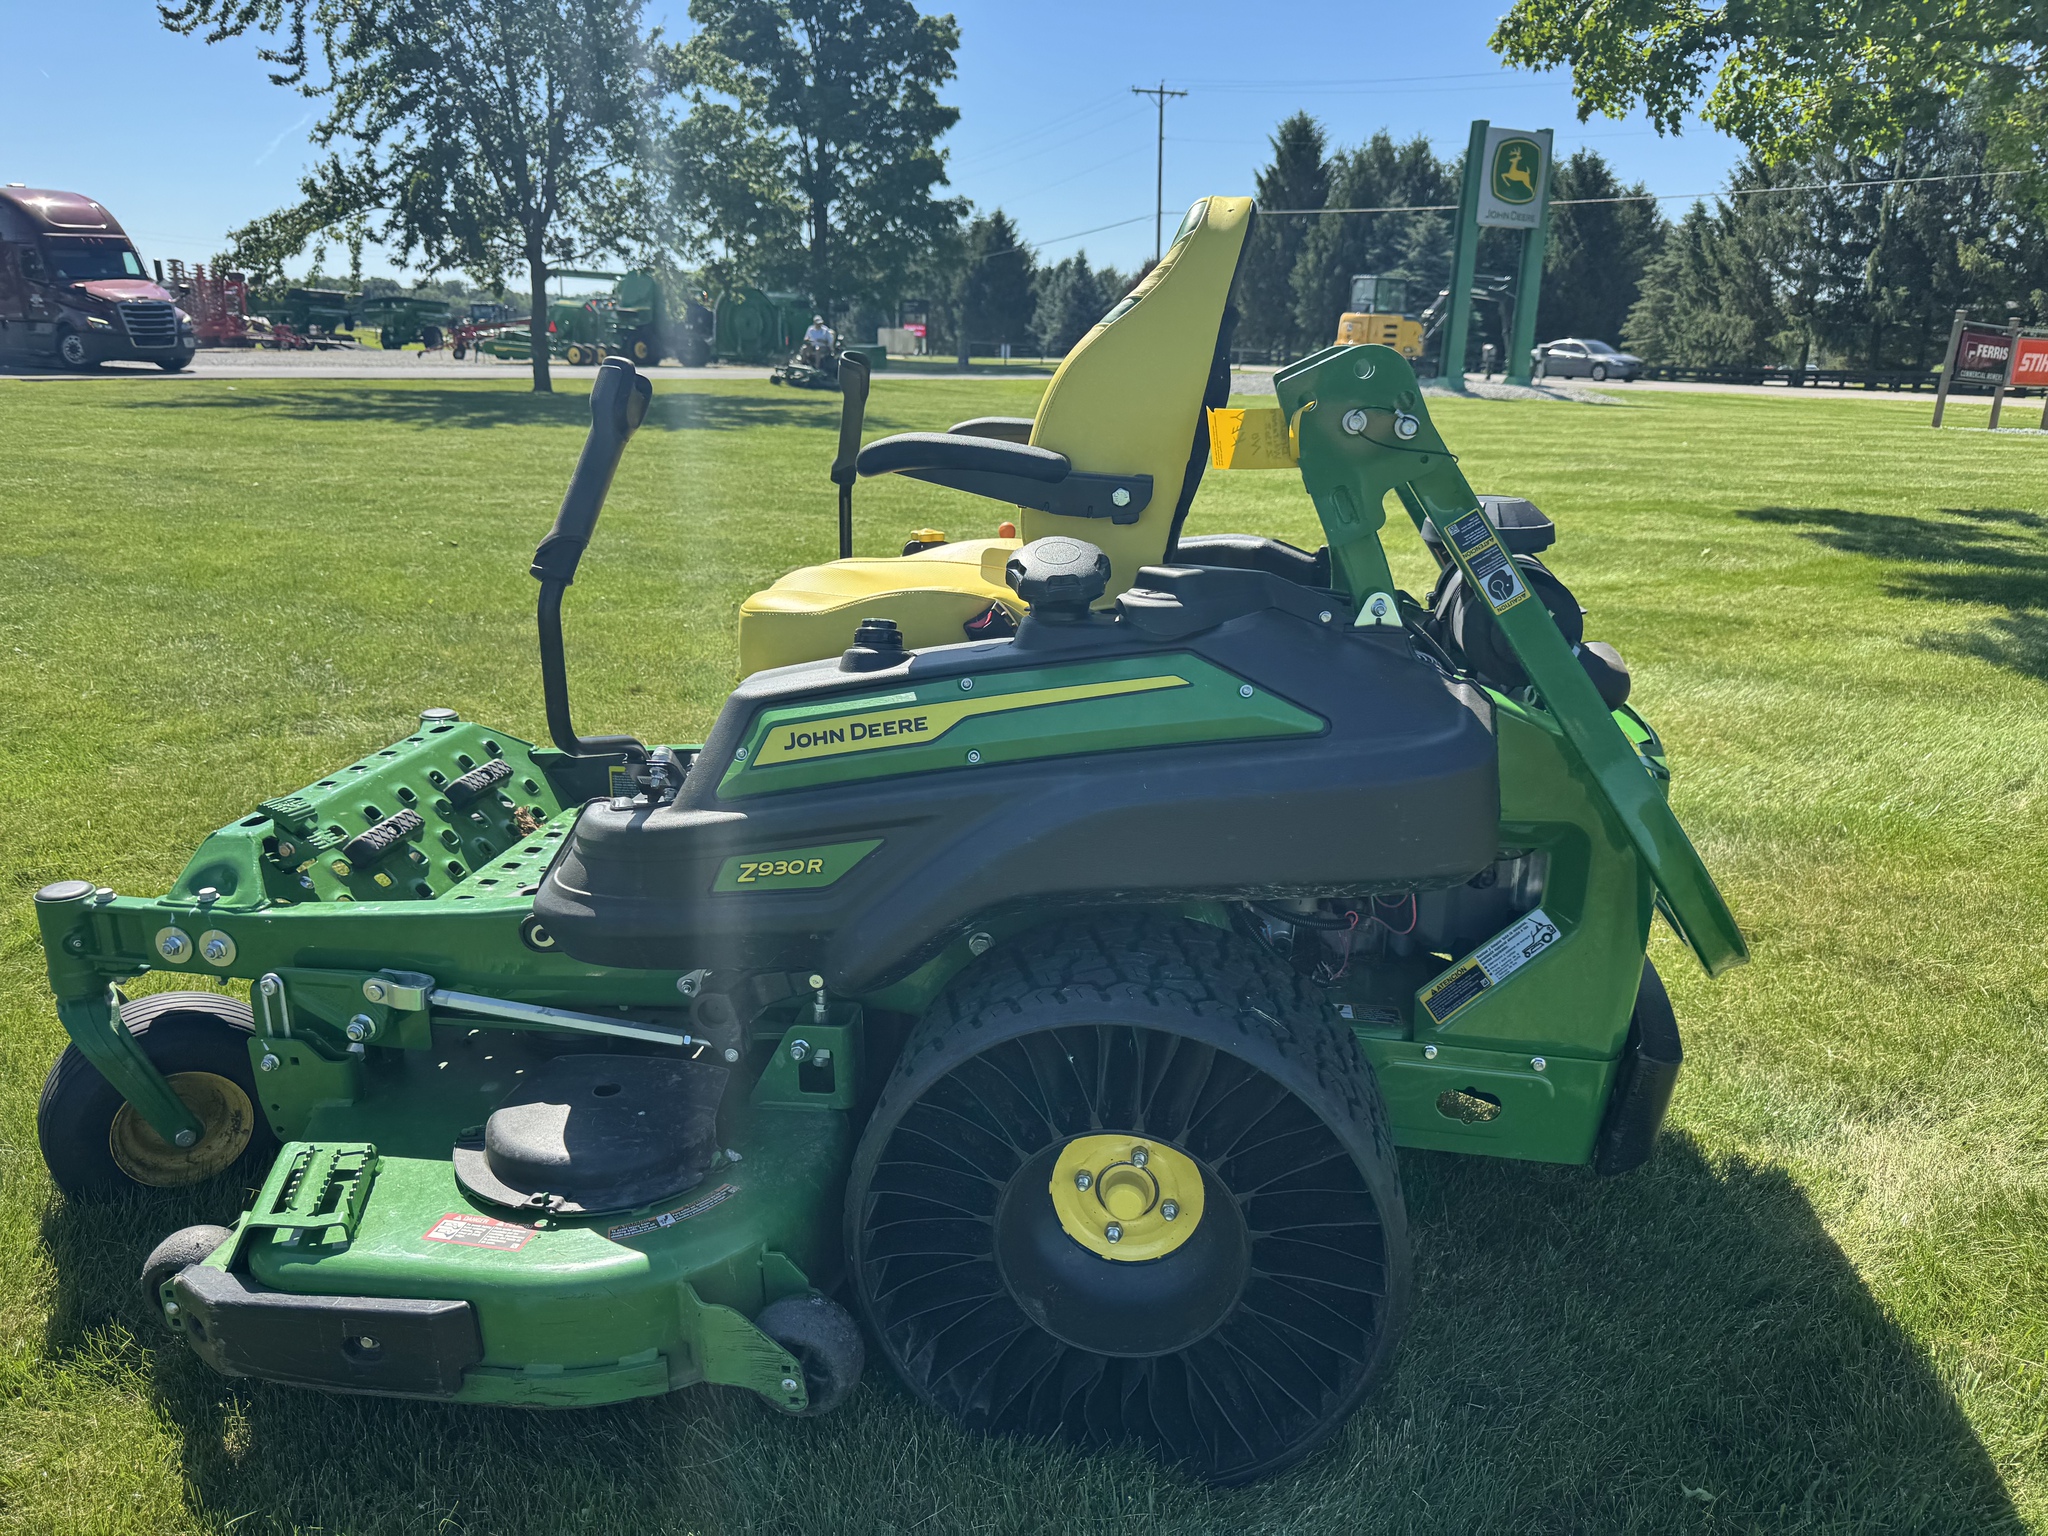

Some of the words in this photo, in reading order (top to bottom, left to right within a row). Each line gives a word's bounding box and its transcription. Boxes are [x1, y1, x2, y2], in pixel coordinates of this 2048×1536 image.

[1485, 209, 1510, 220] JOHN
[1511, 210, 1535, 222] DEERE
[1976, 344, 2009, 361] FERRIS
[1497, 596, 1522, 613] CAUTION
[784, 728, 845, 751] JOHN
[850, 716, 928, 741] DEERE
[737, 858, 824, 883] Z930R
[1436, 966, 1467, 991] ATENCIÓN
[463, 1215, 490, 1224] DANGER
